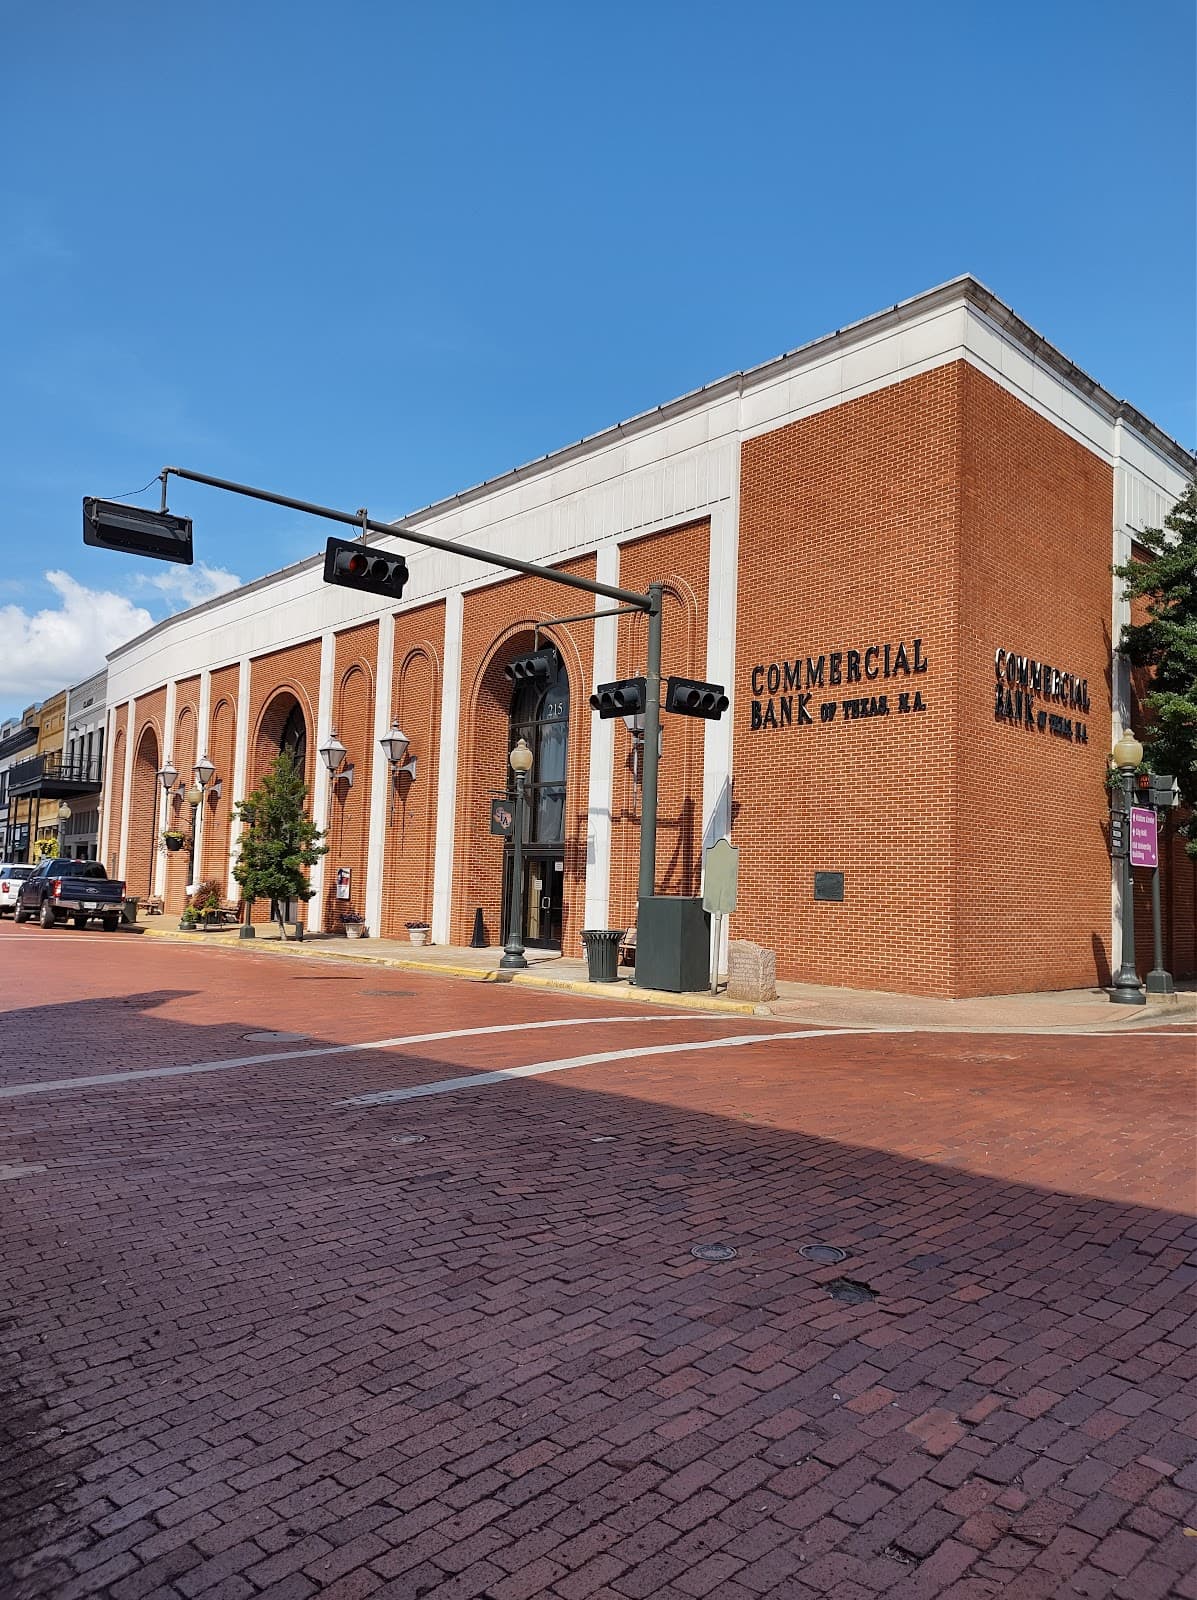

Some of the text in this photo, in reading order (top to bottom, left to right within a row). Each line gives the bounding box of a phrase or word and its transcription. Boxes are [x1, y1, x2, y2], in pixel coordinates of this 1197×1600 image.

[752, 639, 928, 695] COMMERCIAL
[995, 648, 1090, 712] COMMERCIAL
[547, 702, 563, 716] 215
[750, 692, 813, 731] BANK
[995, 683, 1034, 727] BANK
